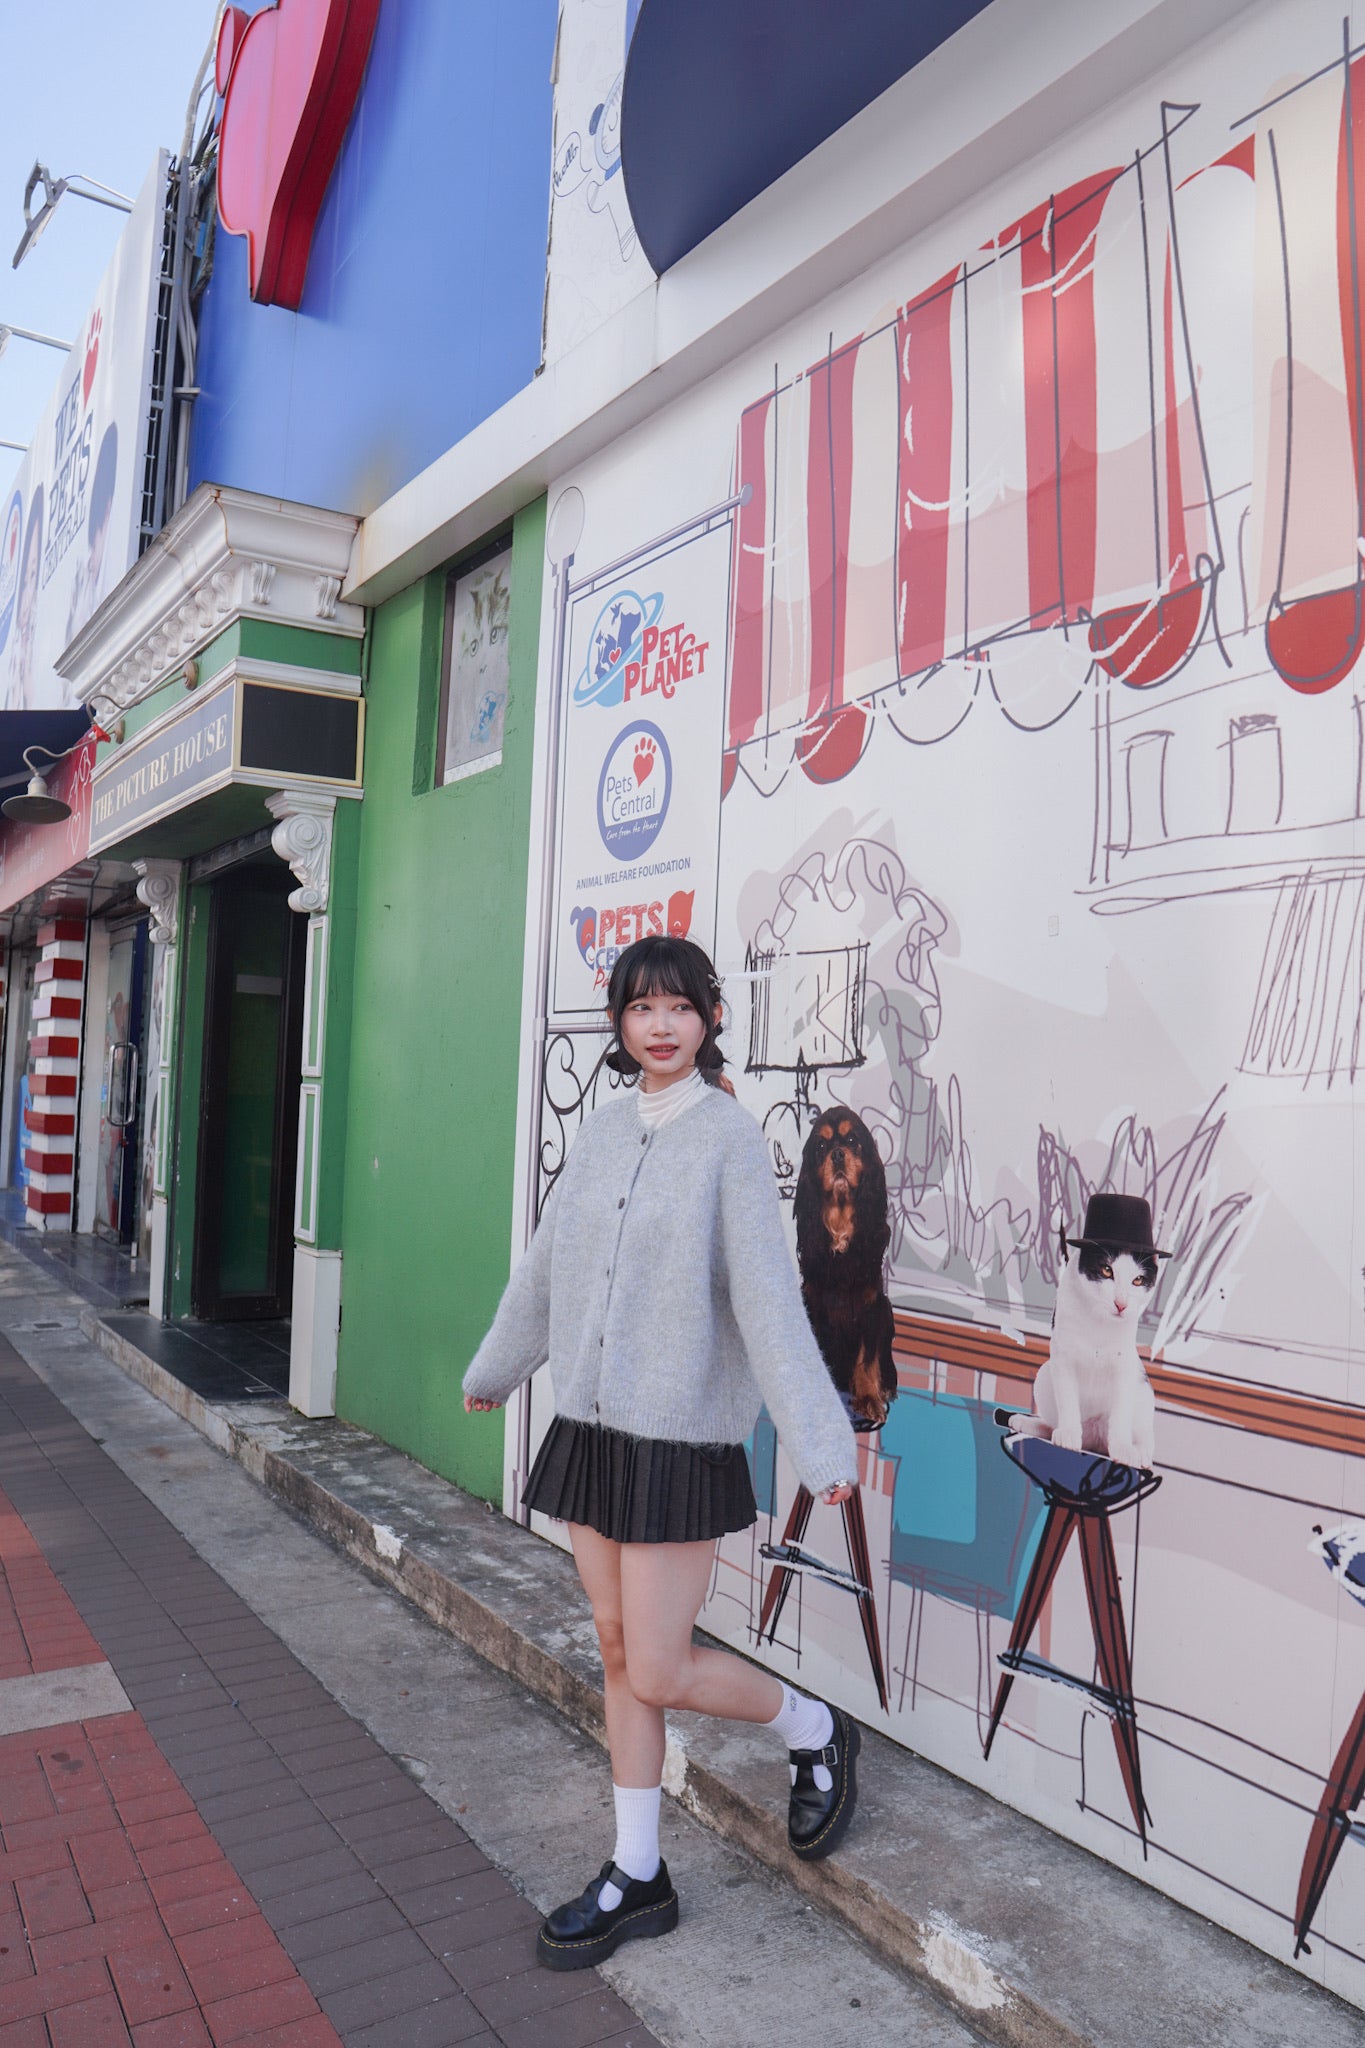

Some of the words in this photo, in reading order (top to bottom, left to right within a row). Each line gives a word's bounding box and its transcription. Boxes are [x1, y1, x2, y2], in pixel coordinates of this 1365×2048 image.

[55, 368, 81, 471] WE
[46, 409, 93, 553] PETS
[641, 622, 687, 667] PET
[623, 636, 709, 703] PLANET
[95, 789, 115, 825] THE
[116, 751, 169, 812] PICTURE
[172, 714, 227, 778] HOUSE
[606, 775, 632, 803] Pets
[611, 787, 656, 823] Central
[576, 874, 604, 891] ANIMAL
[604, 867, 637, 885] WELFARE
[638, 857, 691, 879] FOUNDATION
[599, 900, 664, 948] PETS
